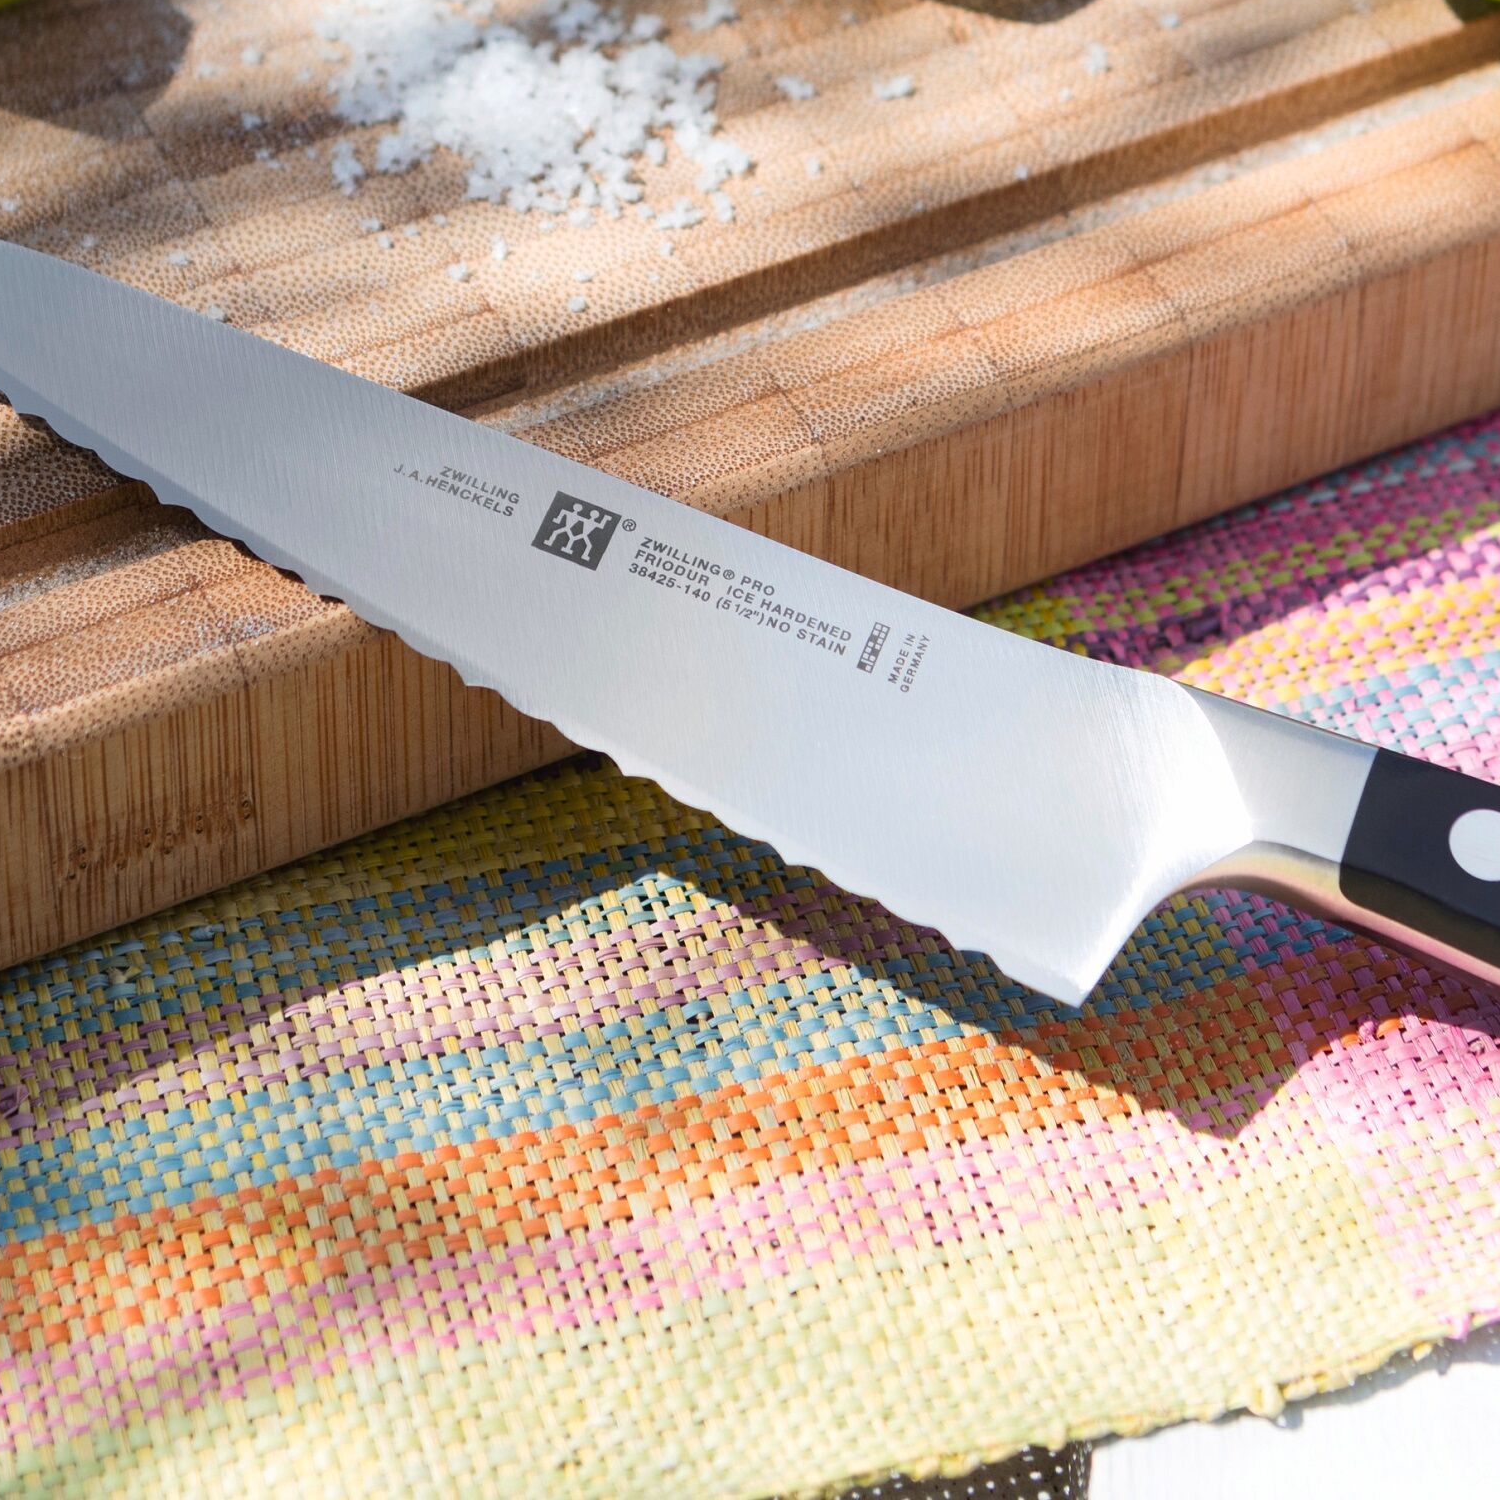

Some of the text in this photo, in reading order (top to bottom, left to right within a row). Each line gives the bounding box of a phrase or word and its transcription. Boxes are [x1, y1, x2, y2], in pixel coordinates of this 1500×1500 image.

[439, 466, 520, 504] ZWILLING
[628, 563, 711, 602] 38425-140
[796, 629, 846, 656] STAIN
[634, 549, 852, 642] FRIODUR ICE HARDENED
[740, 575, 775, 596] PRO
[887, 633, 916, 684] MADE IN
[900, 634, 931, 693] GERMANY
